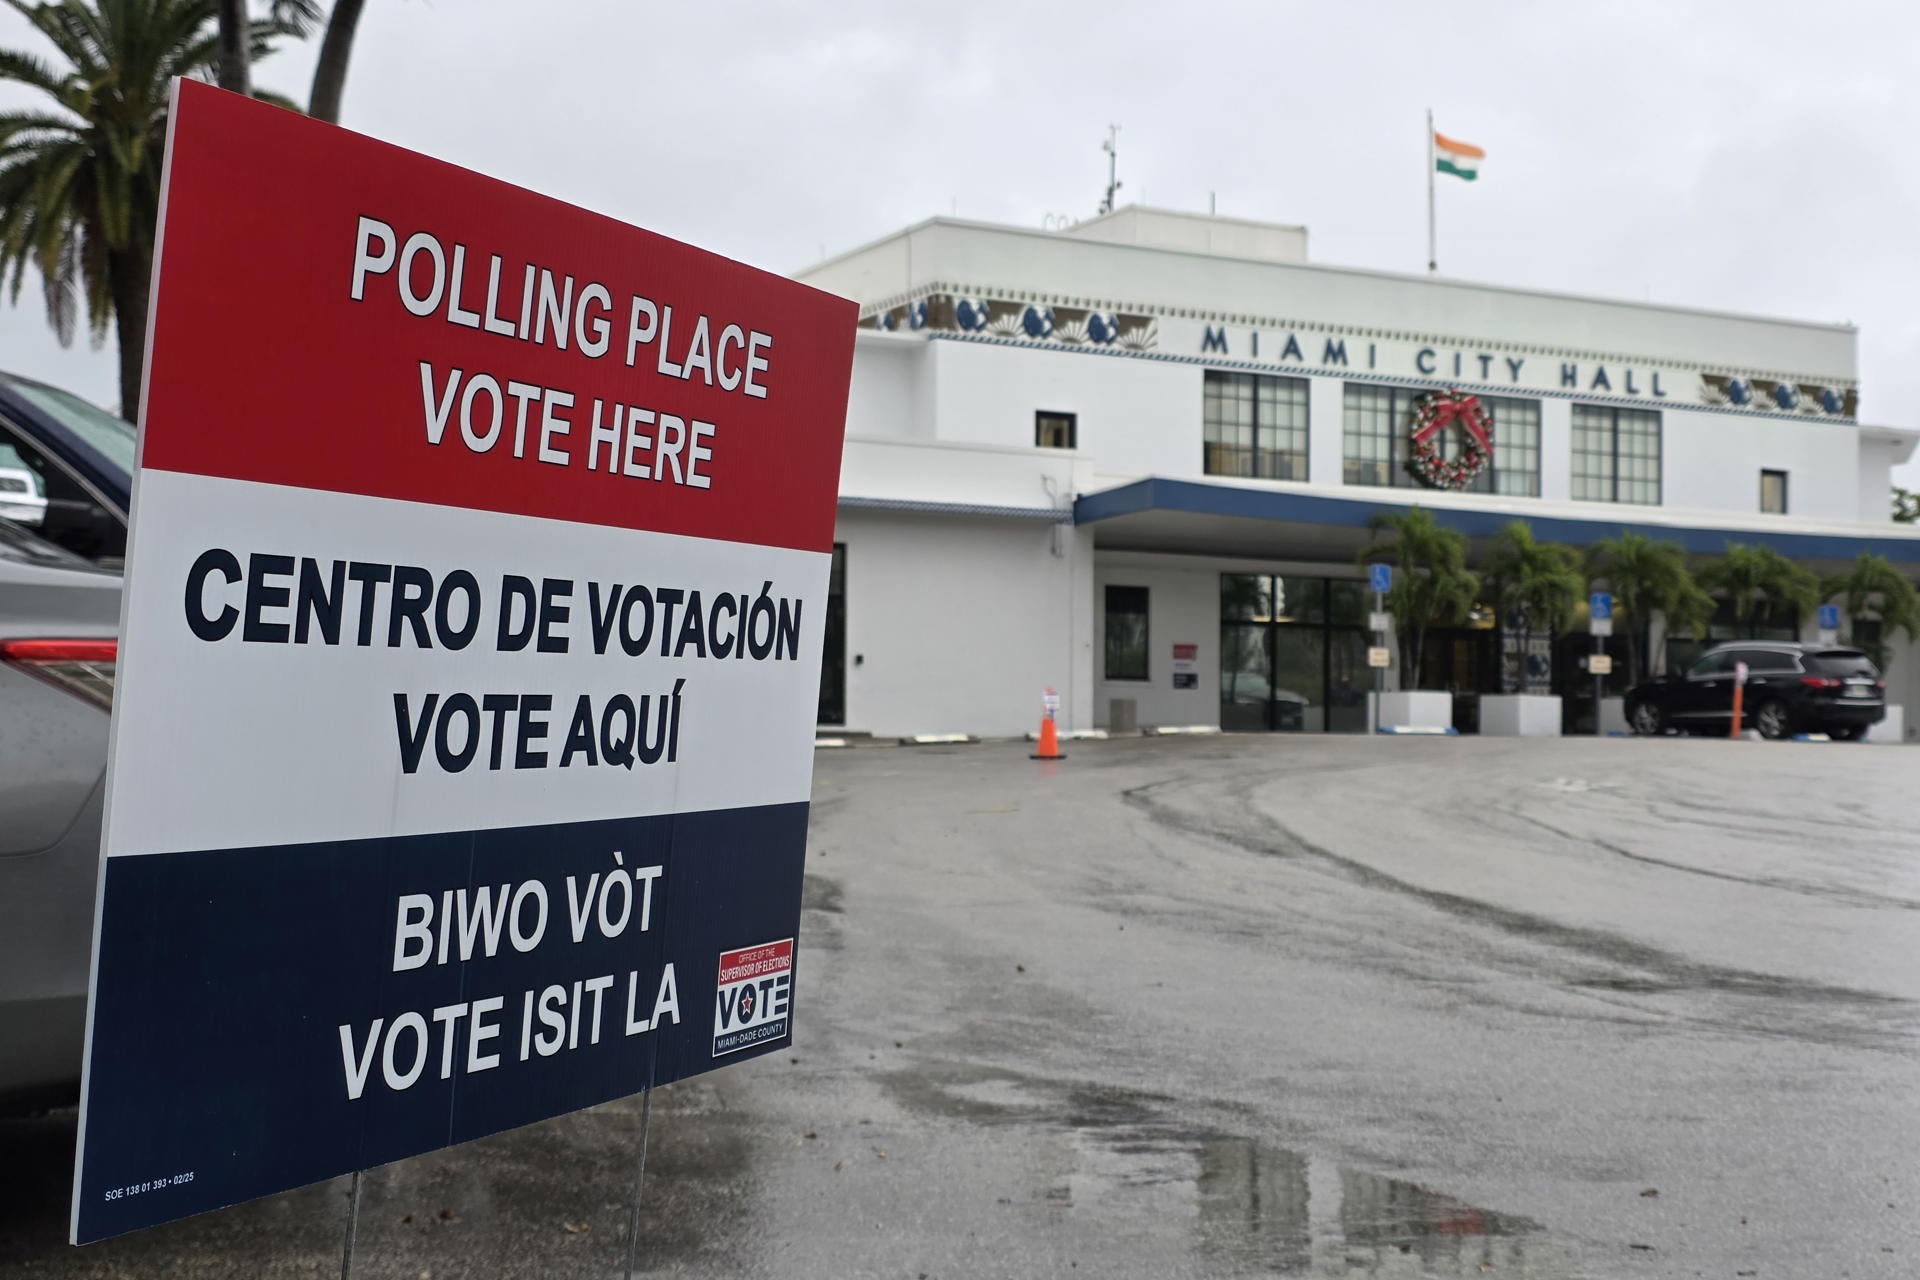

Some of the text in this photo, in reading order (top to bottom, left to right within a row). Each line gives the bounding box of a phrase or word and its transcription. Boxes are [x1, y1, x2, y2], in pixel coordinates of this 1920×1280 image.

[351, 215, 772, 399] POLLING PLACE
[1201, 325, 1667, 397] MIAMI CITY HALL
[419, 362, 716, 489] VOTE HERE
[185, 549, 802, 660] CENTRO DE VOTACIÓN
[393, 678, 686, 774] VOTE AQUÍ
[392, 851, 663, 972] BIWO VÒT
[720, 955, 790, 982] SUPERVISOR OF ELECTIONS
[738, 947, 776, 963] OFFICE OF THE
[338, 962, 681, 1100] VOTE ISIT LA
[717, 1023, 783, 1049] MIAMI-DADE COUNTY
[719, 975, 789, 1030] VOTE
[105, 1188, 124, 1201] SOE
[125, 1184, 140, 1196] 138
[141, 1182, 151, 1193] 01
[153, 1178, 167, 1190] 393
[173, 1172, 195, 1185] 02/25
